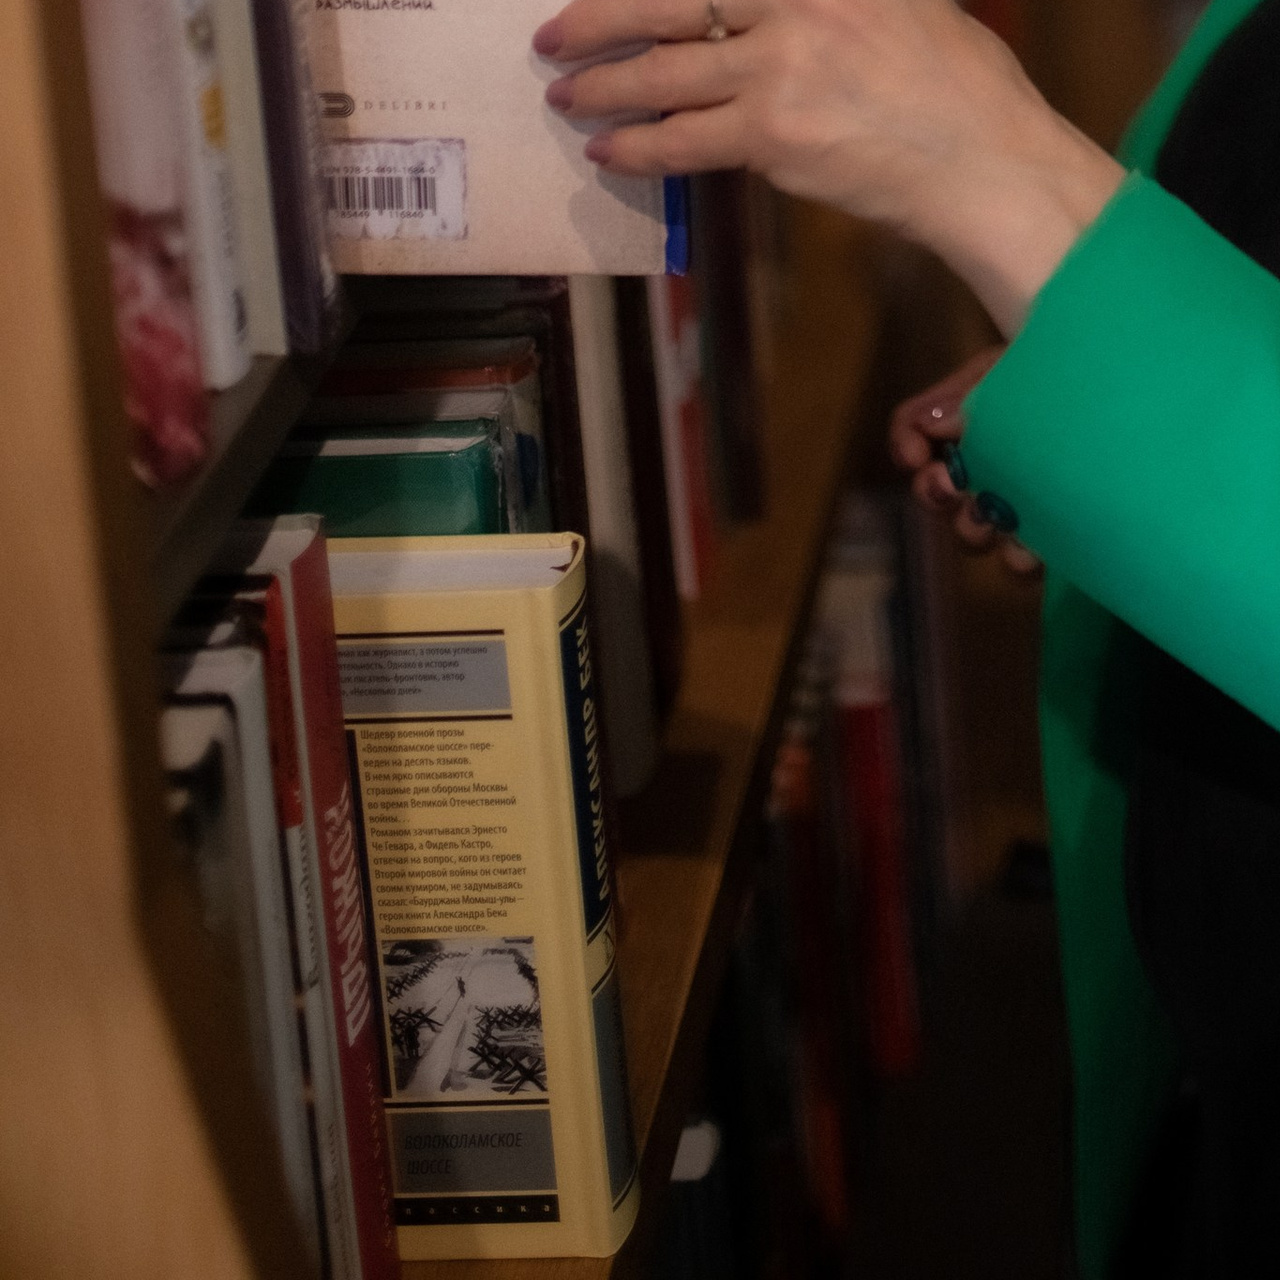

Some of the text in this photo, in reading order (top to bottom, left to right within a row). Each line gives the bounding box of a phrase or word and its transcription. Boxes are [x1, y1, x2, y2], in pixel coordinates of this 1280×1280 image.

[363, 100, 448, 111] DELIBRI
[361, 728, 464, 741] Шедевр военной прозы
[362, 742, 493, 753] «Волоколамское шоссе» пере-
[363, 758, 471, 769] веден на десять языков.
[574, 614, 610, 903] АЛЕКСАНДР БЕК
[366, 771, 473, 783] В нем ярко описываются
[367, 783, 507, 797] страшные дни обороны Москвы
[367, 796, 516, 811] во время Великой Отечественной
[371, 825, 507, 837] Романом зачитывался Эрнесто
[372, 839, 493, 852] Че Гевара, а Фидель Кастро,
[373, 854, 521, 866] отвечая на вопрос, кого из героев
[375, 867, 525, 881] Второй мировой войны он считает
[376, 882, 522, 894] своим кумиром, не задумываясь
[377, 898, 407, 907] сказал:
[409, 895, 460, 907] «Баурджана
[462, 894, 516, 907] Момыш-улы
[324, 778, 371, 1047] ПРЫЖОК
[379, 908, 507, 922] героя книги Александра Бека
[381, 923, 487, 934] «Волоколамское шоссе».
[404, 1132, 522, 1151] ВОЛОКОЛАМСКОЕ
[406, 1159, 452, 1175] ШОССЕ
[405, 1203, 550, 1216] лассика
